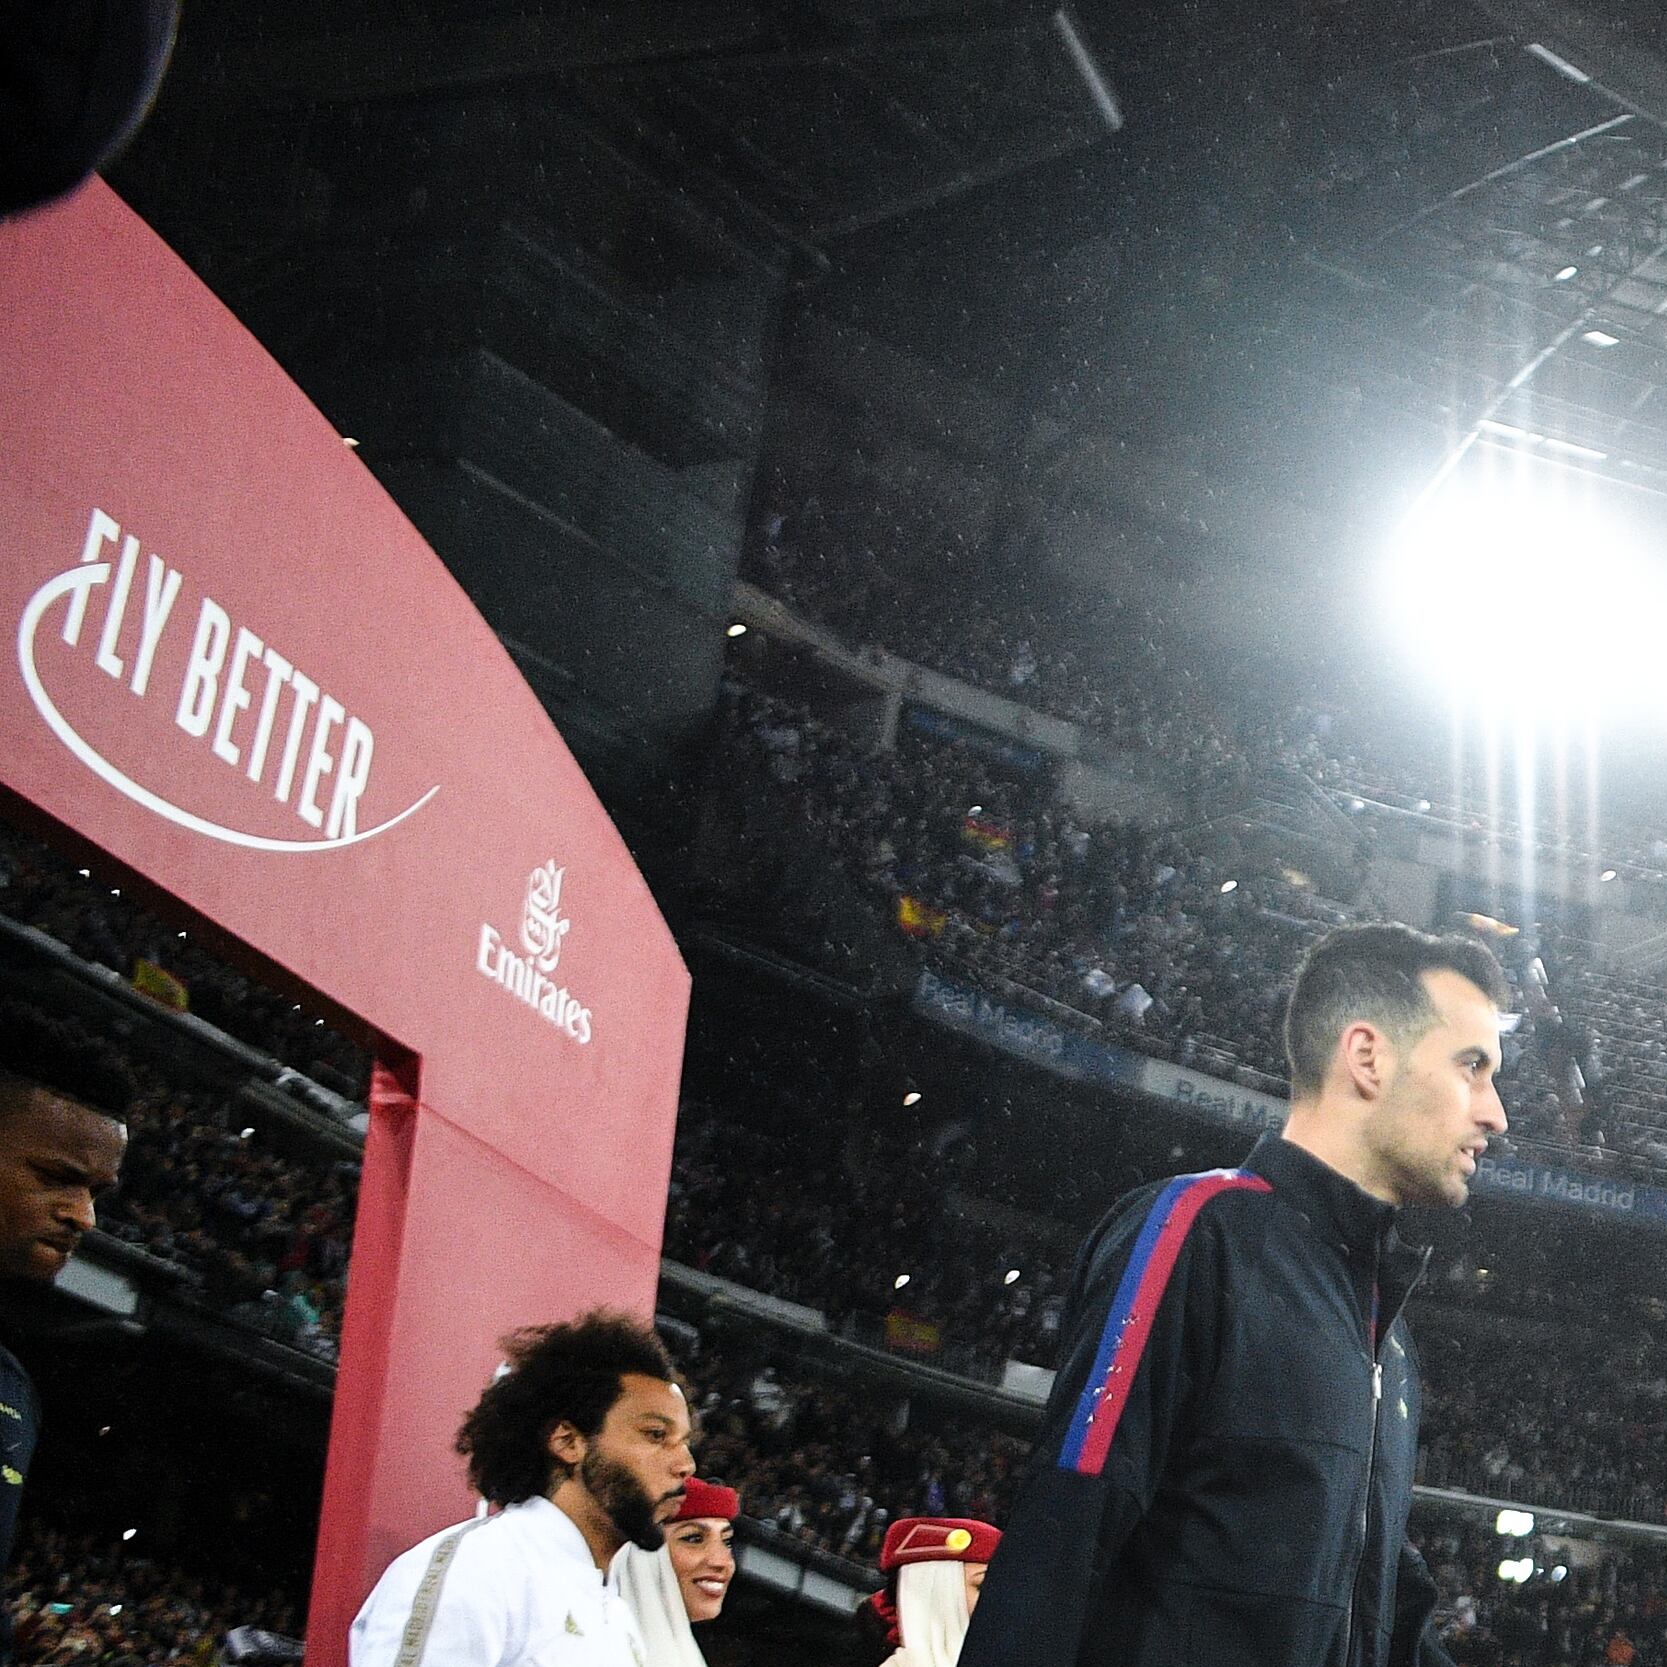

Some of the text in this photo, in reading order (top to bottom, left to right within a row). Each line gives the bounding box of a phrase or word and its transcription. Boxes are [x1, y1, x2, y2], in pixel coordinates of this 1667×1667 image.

[62, 507, 375, 840] FLY BETTER
[475, 921, 594, 1046] Emirates
